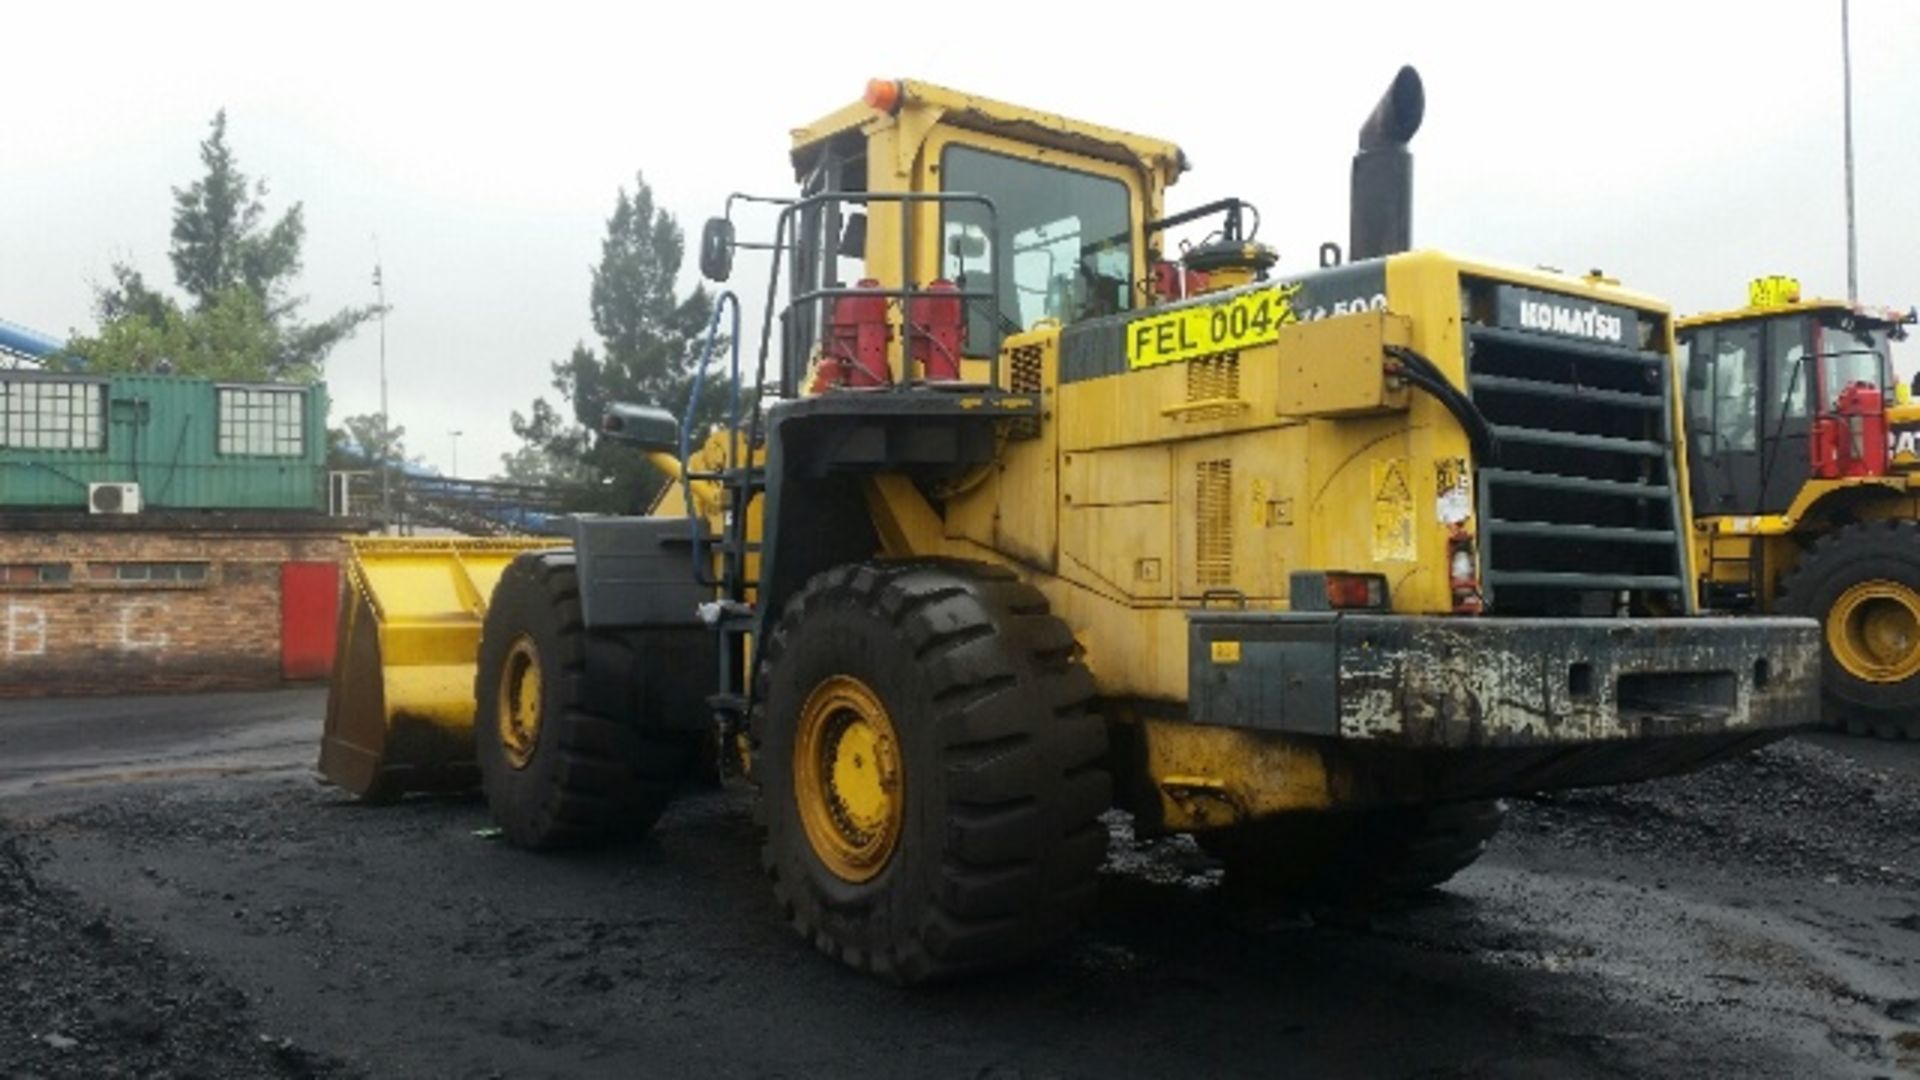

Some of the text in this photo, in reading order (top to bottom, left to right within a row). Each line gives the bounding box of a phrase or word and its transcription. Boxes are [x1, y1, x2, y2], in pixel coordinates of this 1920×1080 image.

[1136, 295, 1296, 361] FEL 0042
[1519, 299, 1622, 342] KOMATSU
[8, 604, 46, 655] B
